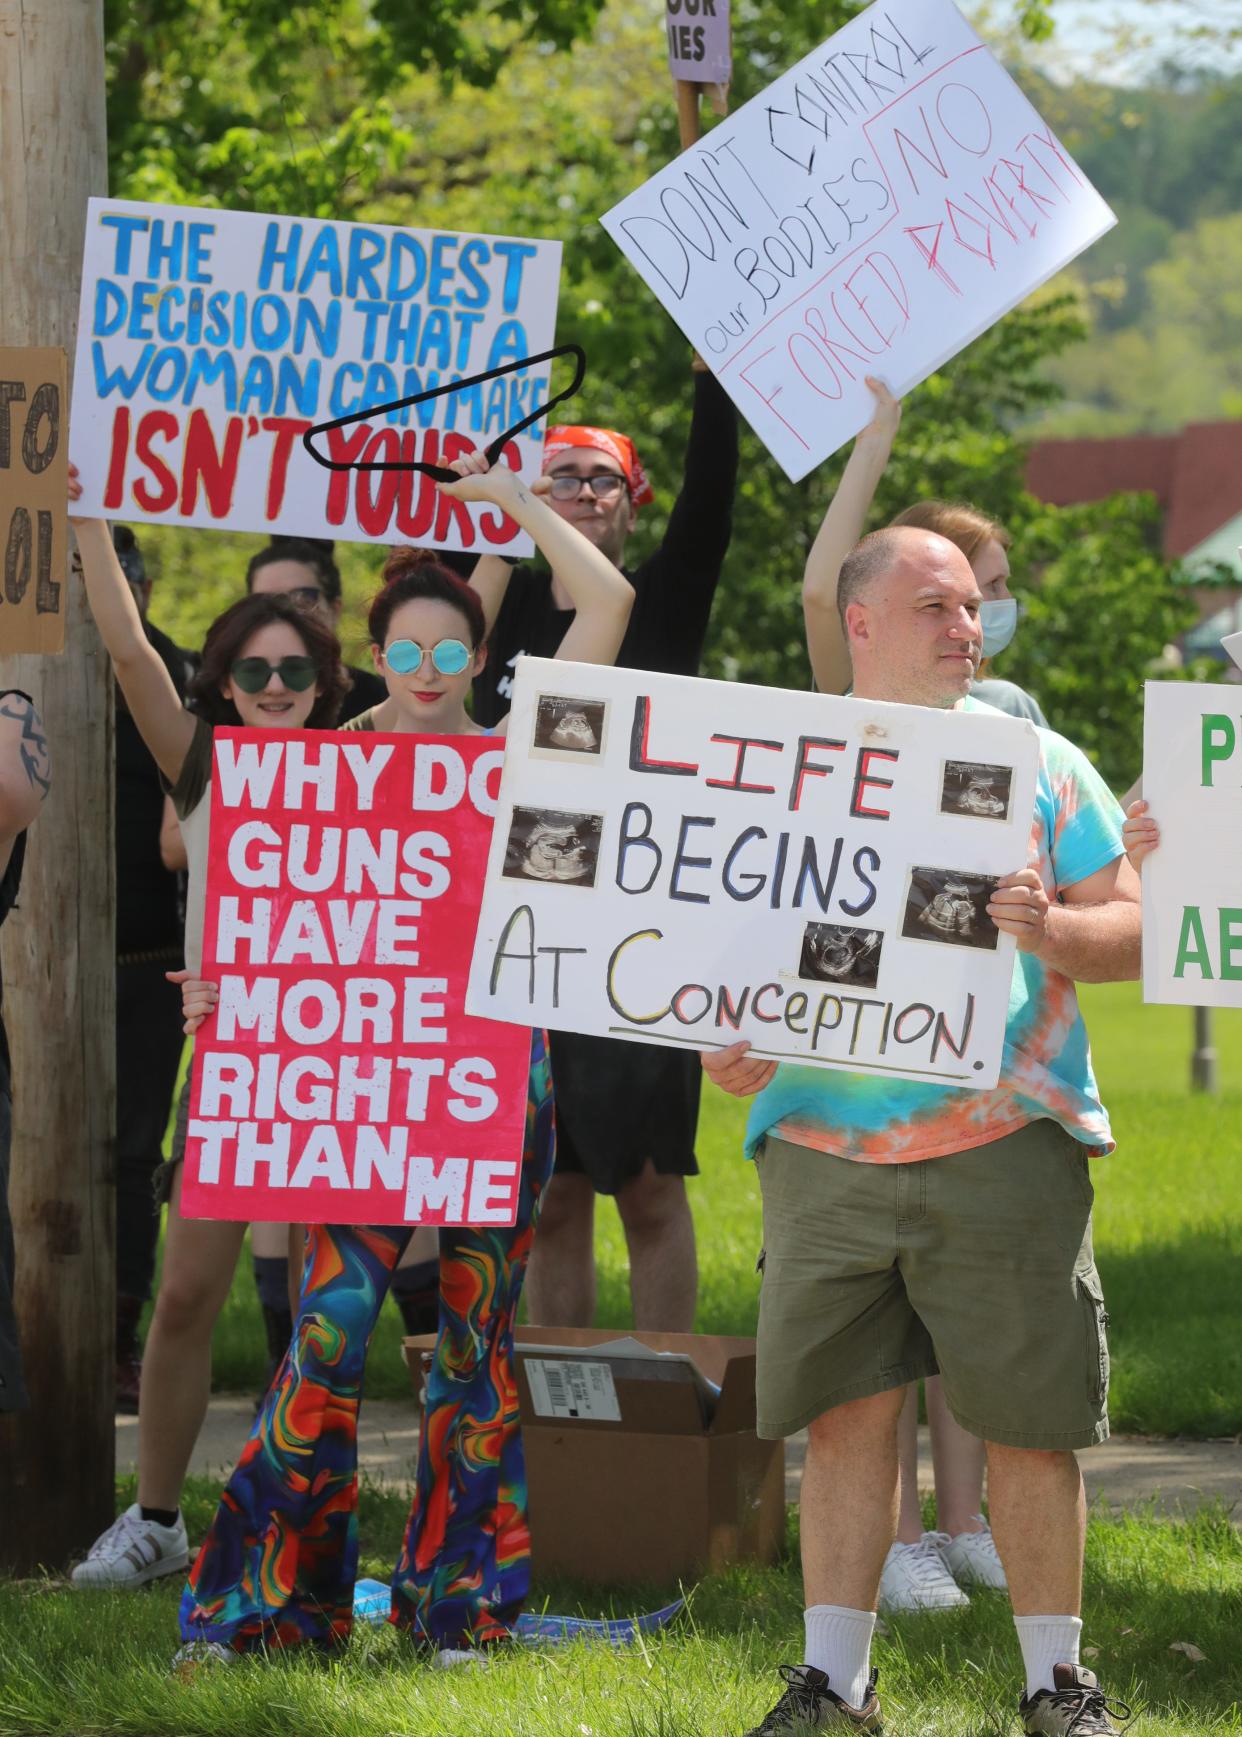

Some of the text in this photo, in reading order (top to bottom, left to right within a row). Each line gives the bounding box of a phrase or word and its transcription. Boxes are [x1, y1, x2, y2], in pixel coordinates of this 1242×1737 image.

[619, 12, 937, 300] DON'T CONTROL
[893, 82, 992, 195] NO
[100, 212, 538, 315] THE HARDEST
[734, 157, 889, 316] BODIES
[739, 124, 1084, 450] FORCED POVERTY
[92, 278, 528, 378] DECISION THAT A
[91, 340, 548, 442] WOMAN CAN MAKE
[103, 405, 523, 548] ISN'T YOURS
[0, 506, 60, 615] OL
[214, 739, 506, 817] WHY DO
[628, 695, 899, 821] LIFE
[1200, 713, 1242, 788] P
[227, 820, 452, 899] GUNS
[615, 801, 881, 917] BEGINS
[215, 896, 422, 966] HAVE
[489, 904, 587, 1008] AT
[215, 975, 448, 1046] MORE
[199, 1051, 500, 1123] RIGHTS
[187, 1121, 517, 1223] THAN ME
